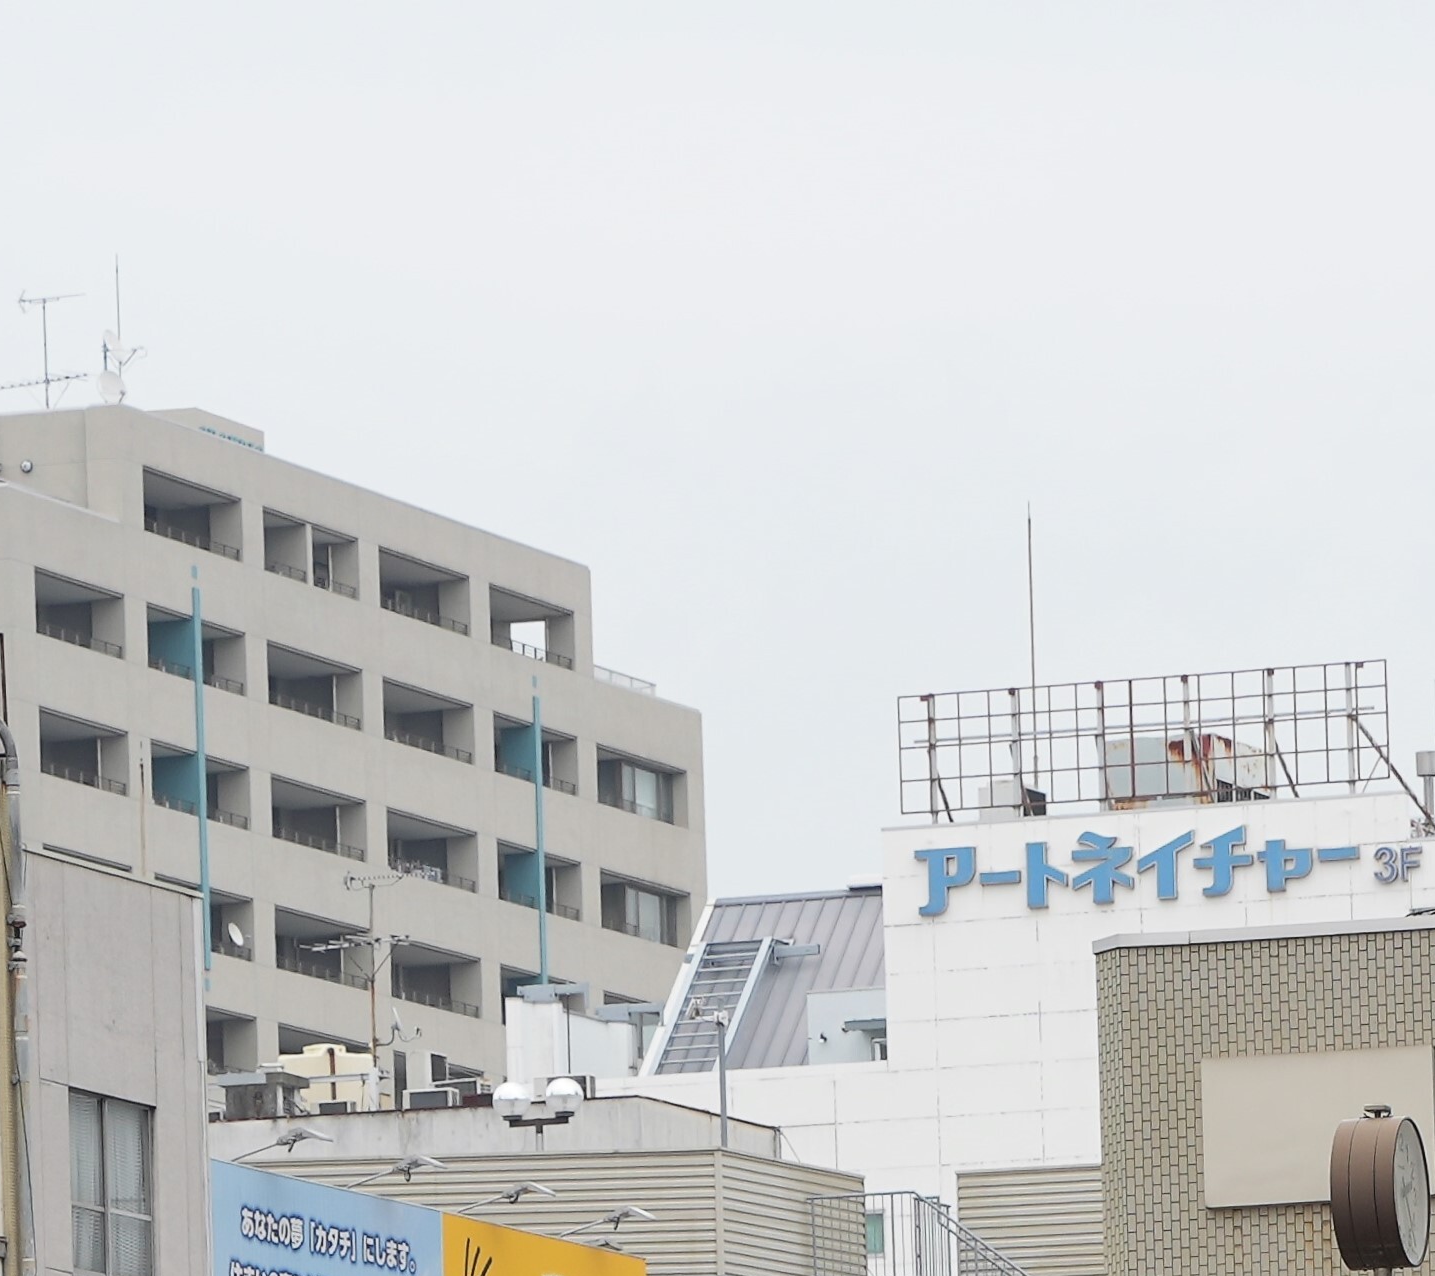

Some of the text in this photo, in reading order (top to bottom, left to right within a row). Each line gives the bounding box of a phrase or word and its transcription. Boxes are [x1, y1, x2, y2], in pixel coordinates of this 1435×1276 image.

[914, 825, 1423, 917] アートネイチャー 3F
[241, 1205, 416, 1274] あなたの夢「カタチ」にします。
